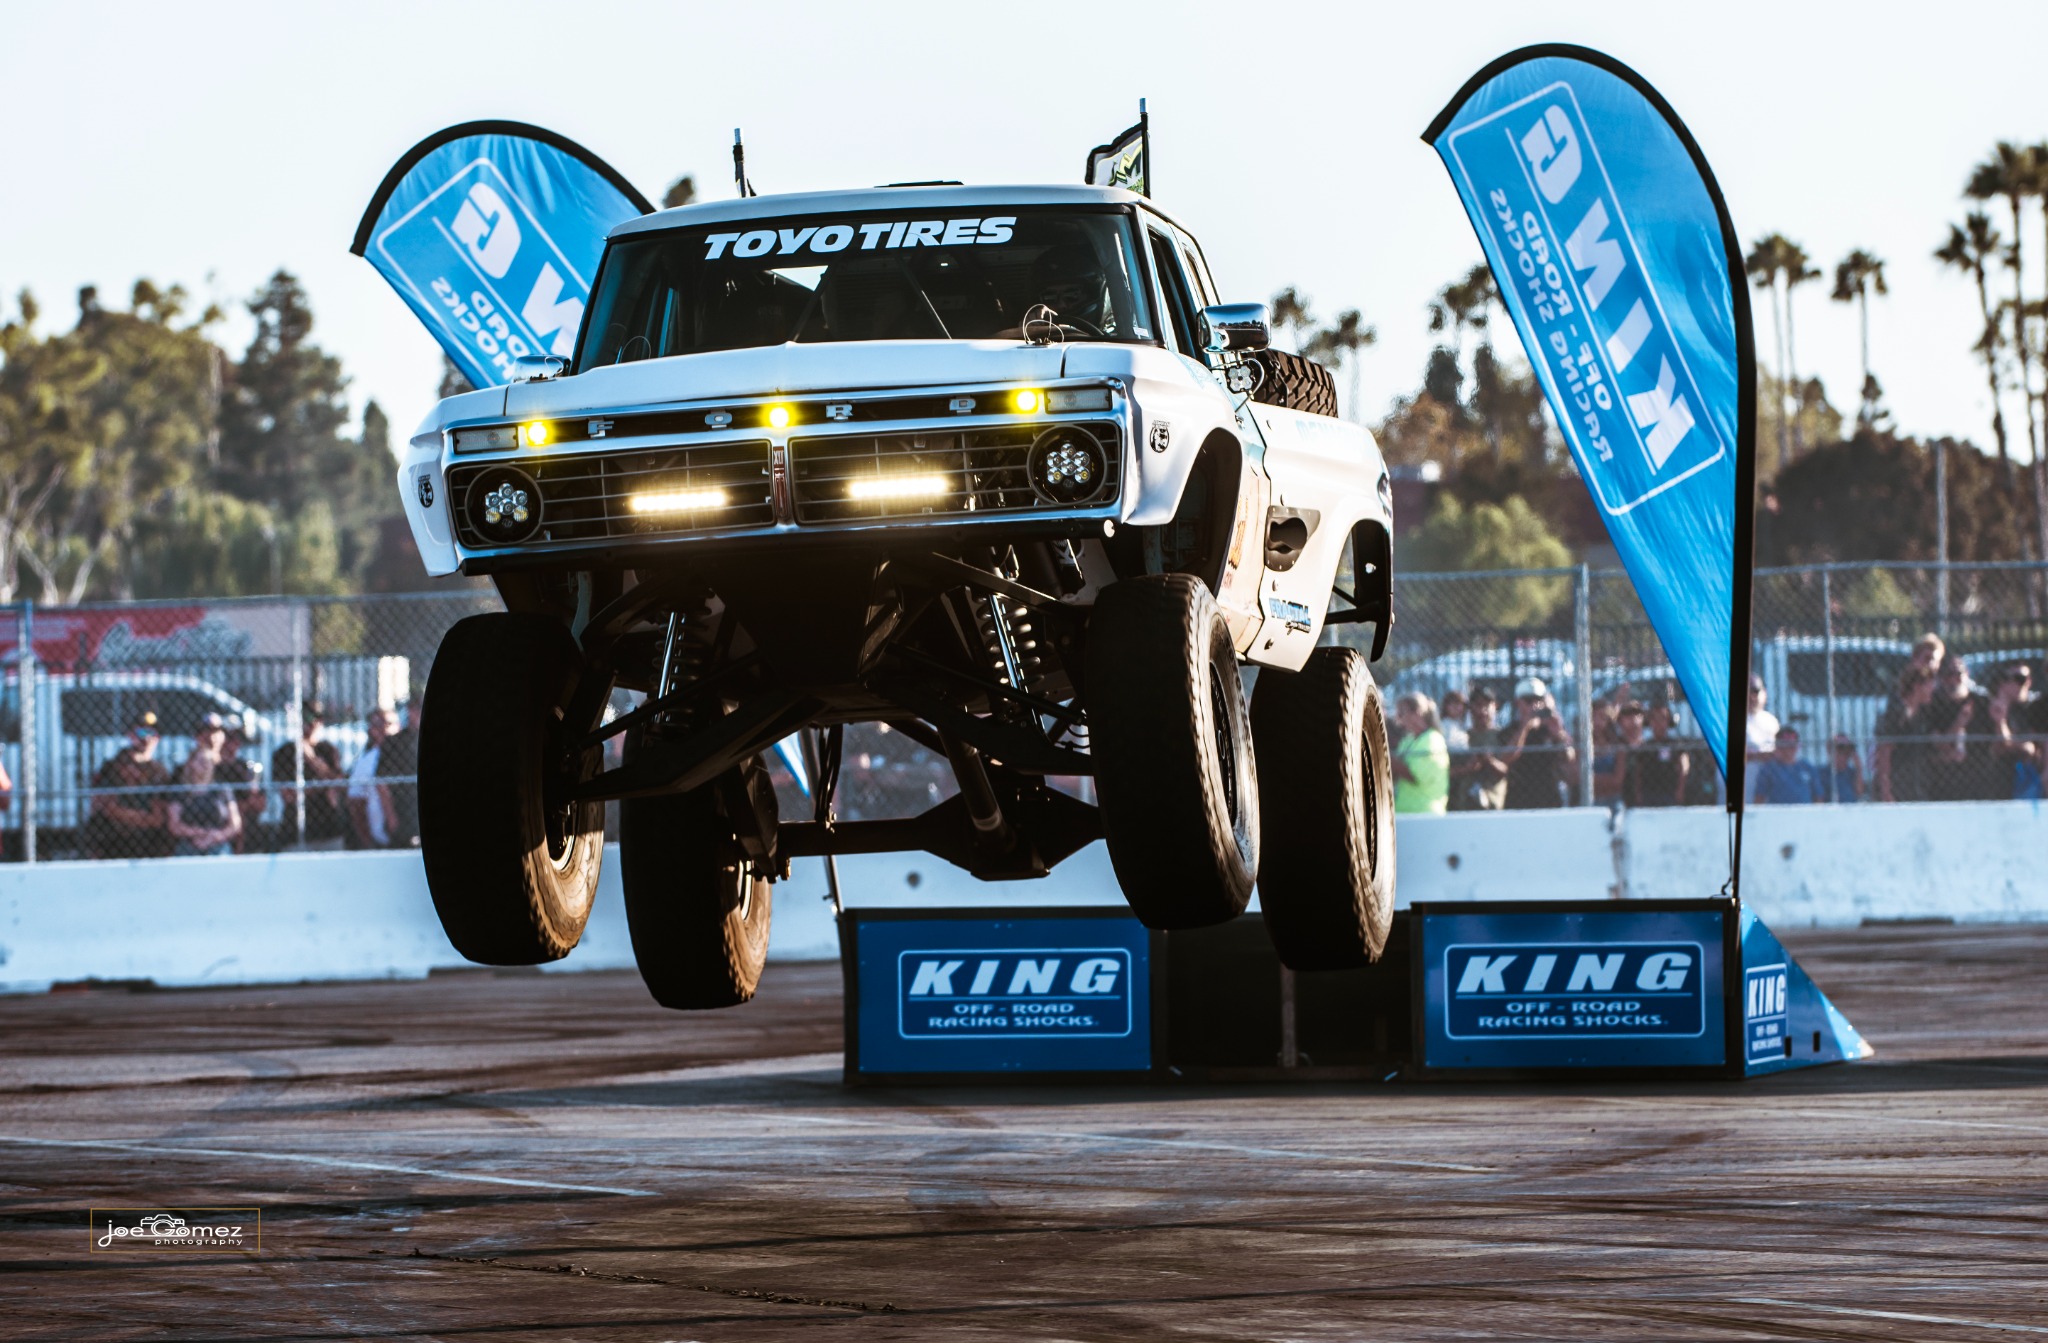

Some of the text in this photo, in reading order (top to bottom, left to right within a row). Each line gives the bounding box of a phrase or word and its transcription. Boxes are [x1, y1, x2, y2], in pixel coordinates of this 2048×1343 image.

[704, 217, 1017, 260] TOYO TIRES
[909, 958, 1121, 995] KING
[1456, 952, 1692, 993] KING
[1012, 1003, 1075, 1014] ROAD
[1571, 1001, 1641, 1013] ROAD
[1748, 974, 1786, 1018] KING
[928, 1016, 1008, 1028] RACING
[1478, 1015, 1567, 1028] RACING
